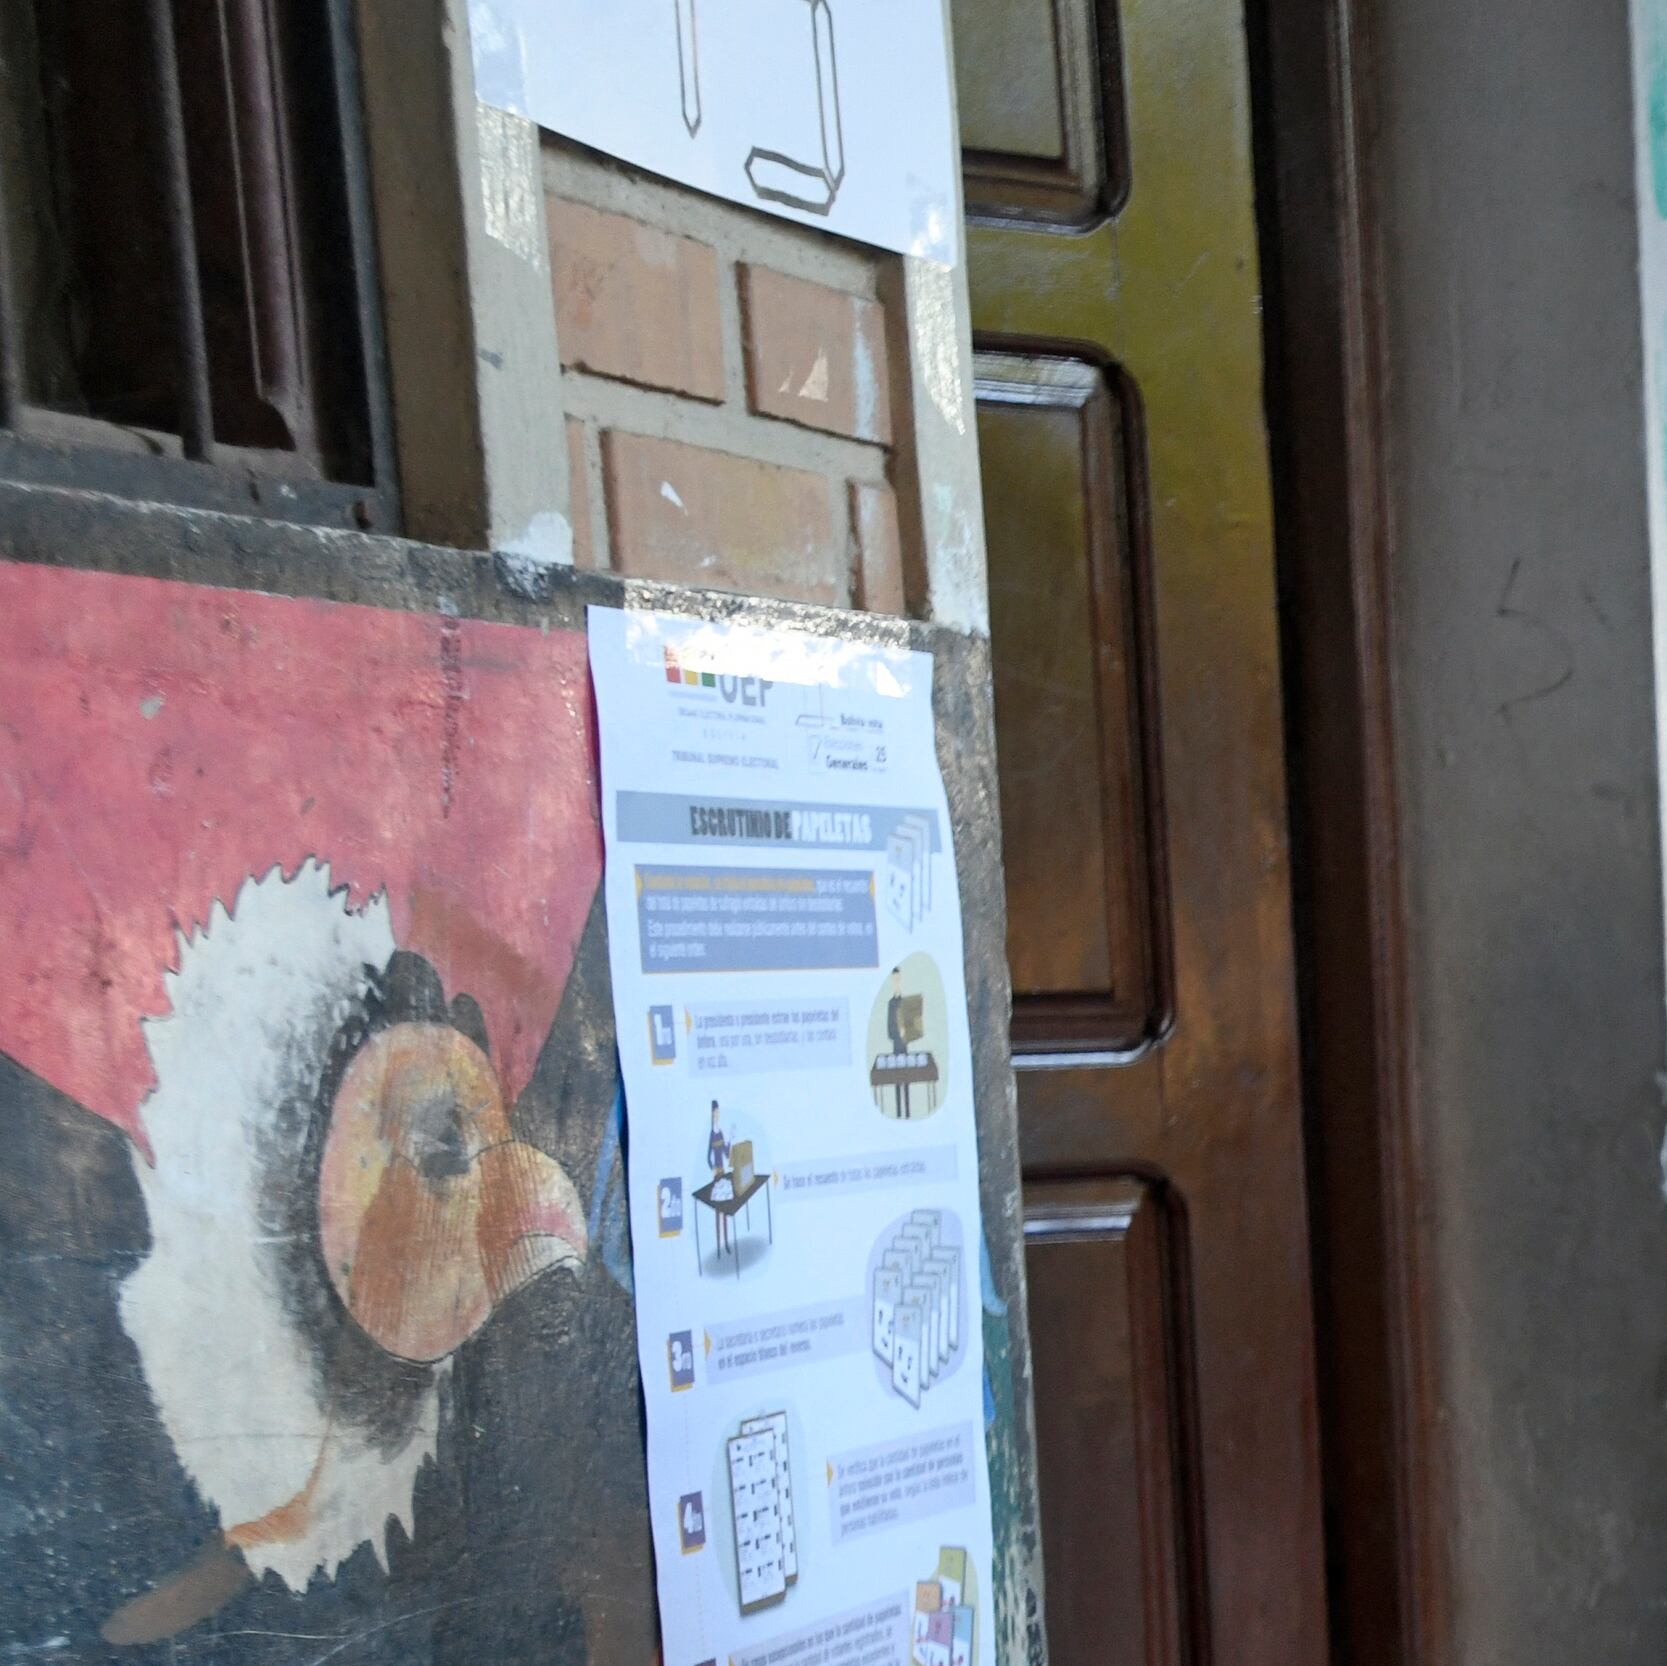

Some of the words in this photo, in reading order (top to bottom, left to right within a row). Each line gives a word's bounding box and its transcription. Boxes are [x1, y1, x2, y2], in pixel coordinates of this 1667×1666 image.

[690, 805, 772, 839] ESCRUTINIO
[774, 811, 793, 840] DE
[792, 810, 873, 844] PAPELETAS
